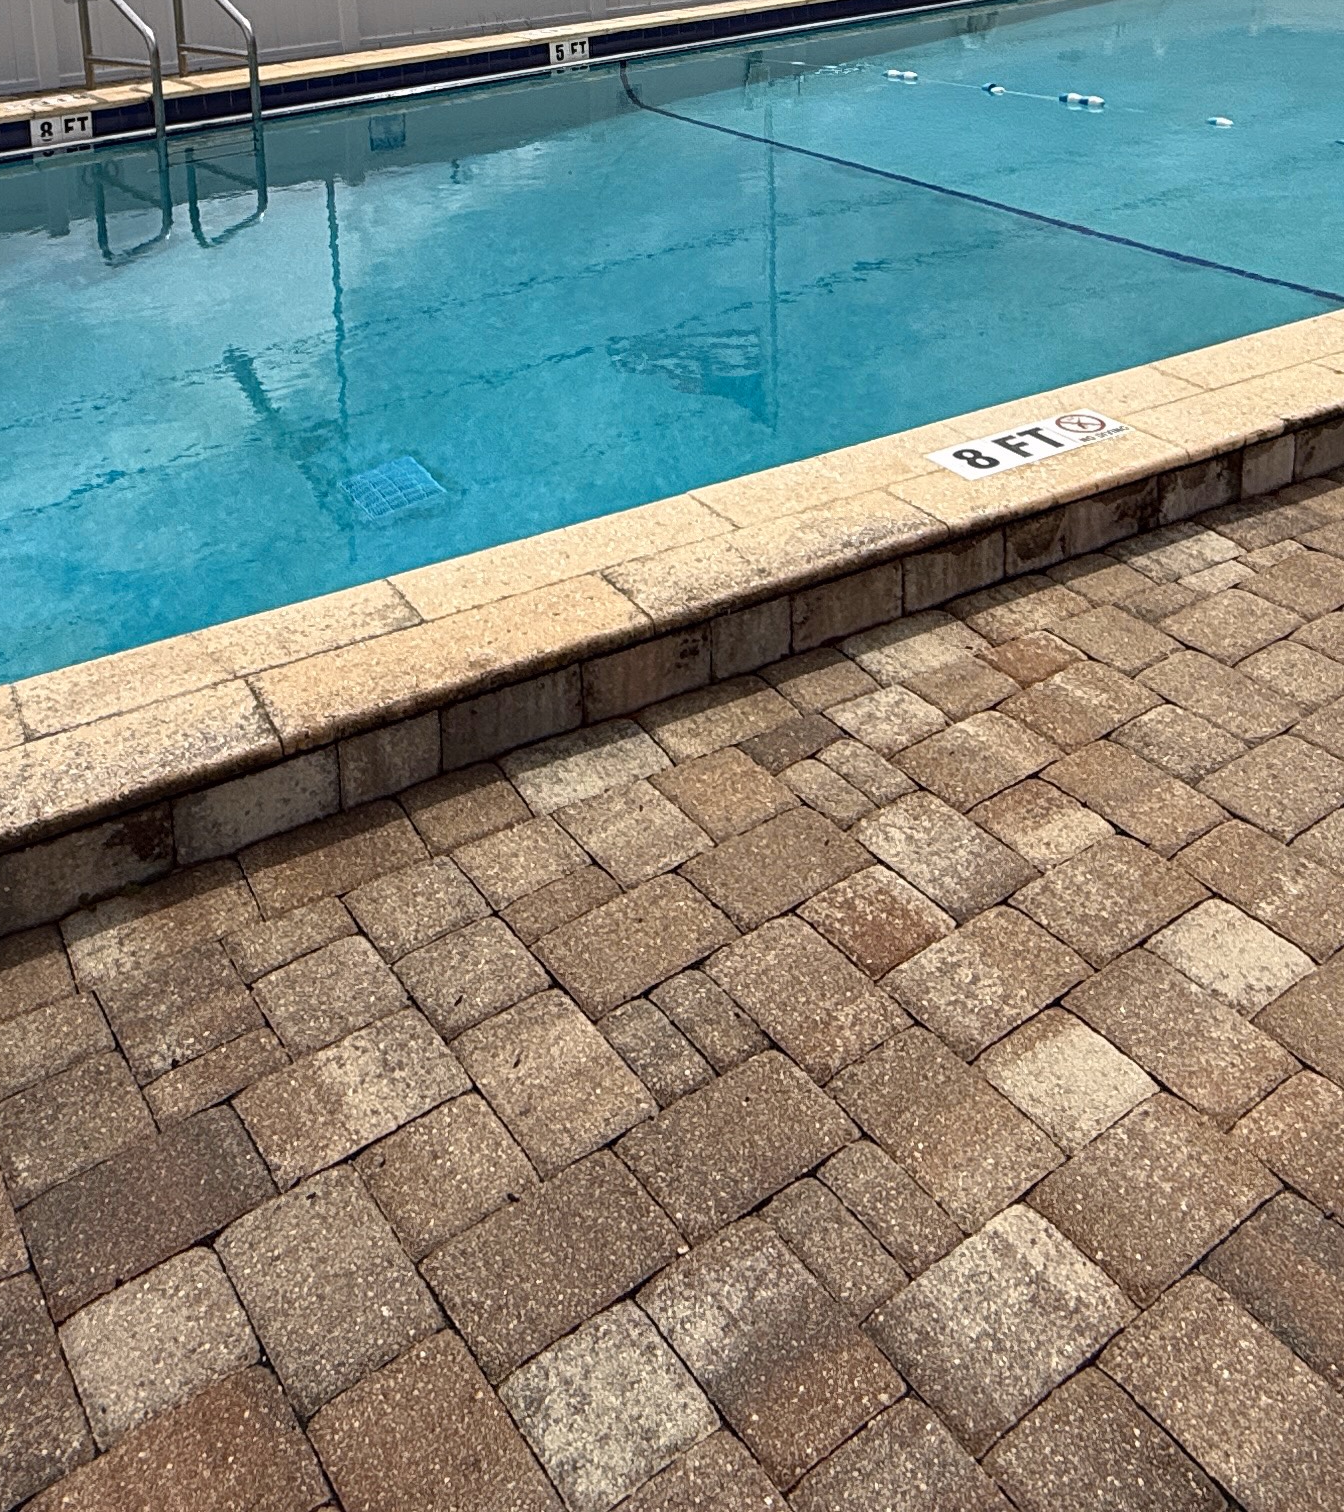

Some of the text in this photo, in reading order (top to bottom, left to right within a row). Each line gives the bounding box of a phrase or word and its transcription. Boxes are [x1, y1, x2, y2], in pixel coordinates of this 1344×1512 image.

[555, 40, 587, 61] 5 FT
[40, 116, 89, 142] 8 FT
[953, 426, 1066, 470] 8 FT
